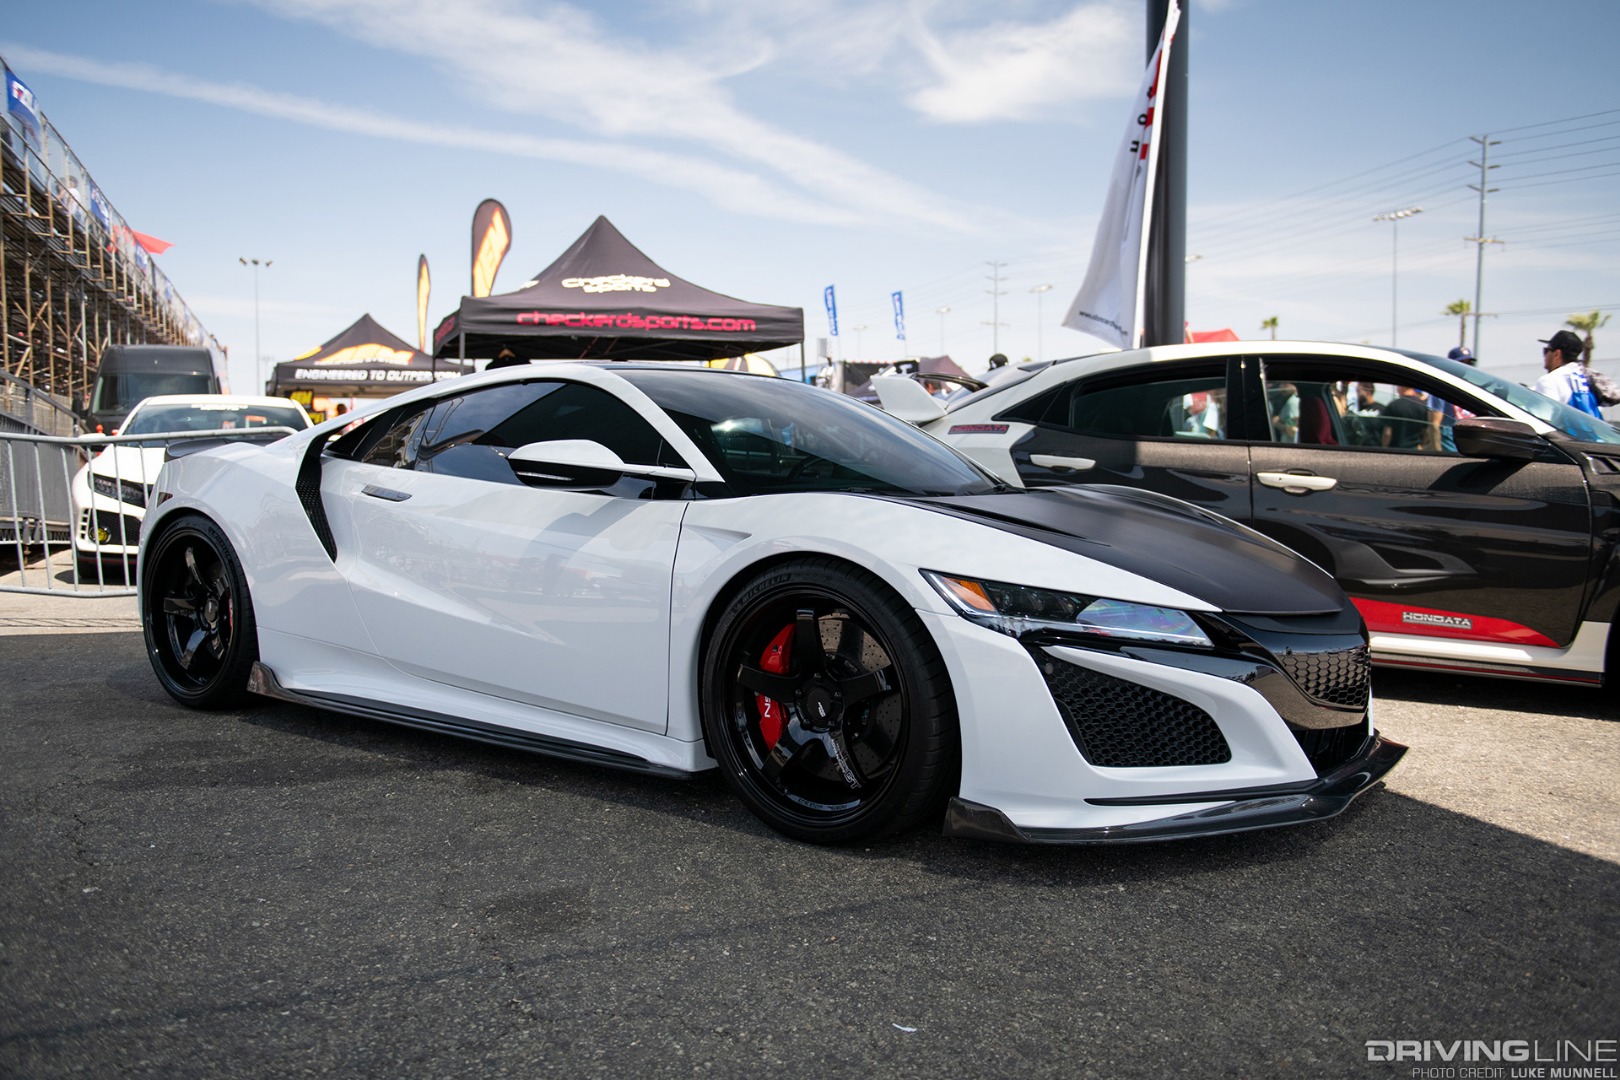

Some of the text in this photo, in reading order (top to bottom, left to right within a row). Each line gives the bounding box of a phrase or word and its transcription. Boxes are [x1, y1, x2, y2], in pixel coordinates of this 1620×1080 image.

[516, 311, 756, 331] checkerdsports.com
[295, 368, 368, 381] ENGINEERED
[370, 369, 387, 380] TO
[1402, 611, 1472, 626] HONDATA
